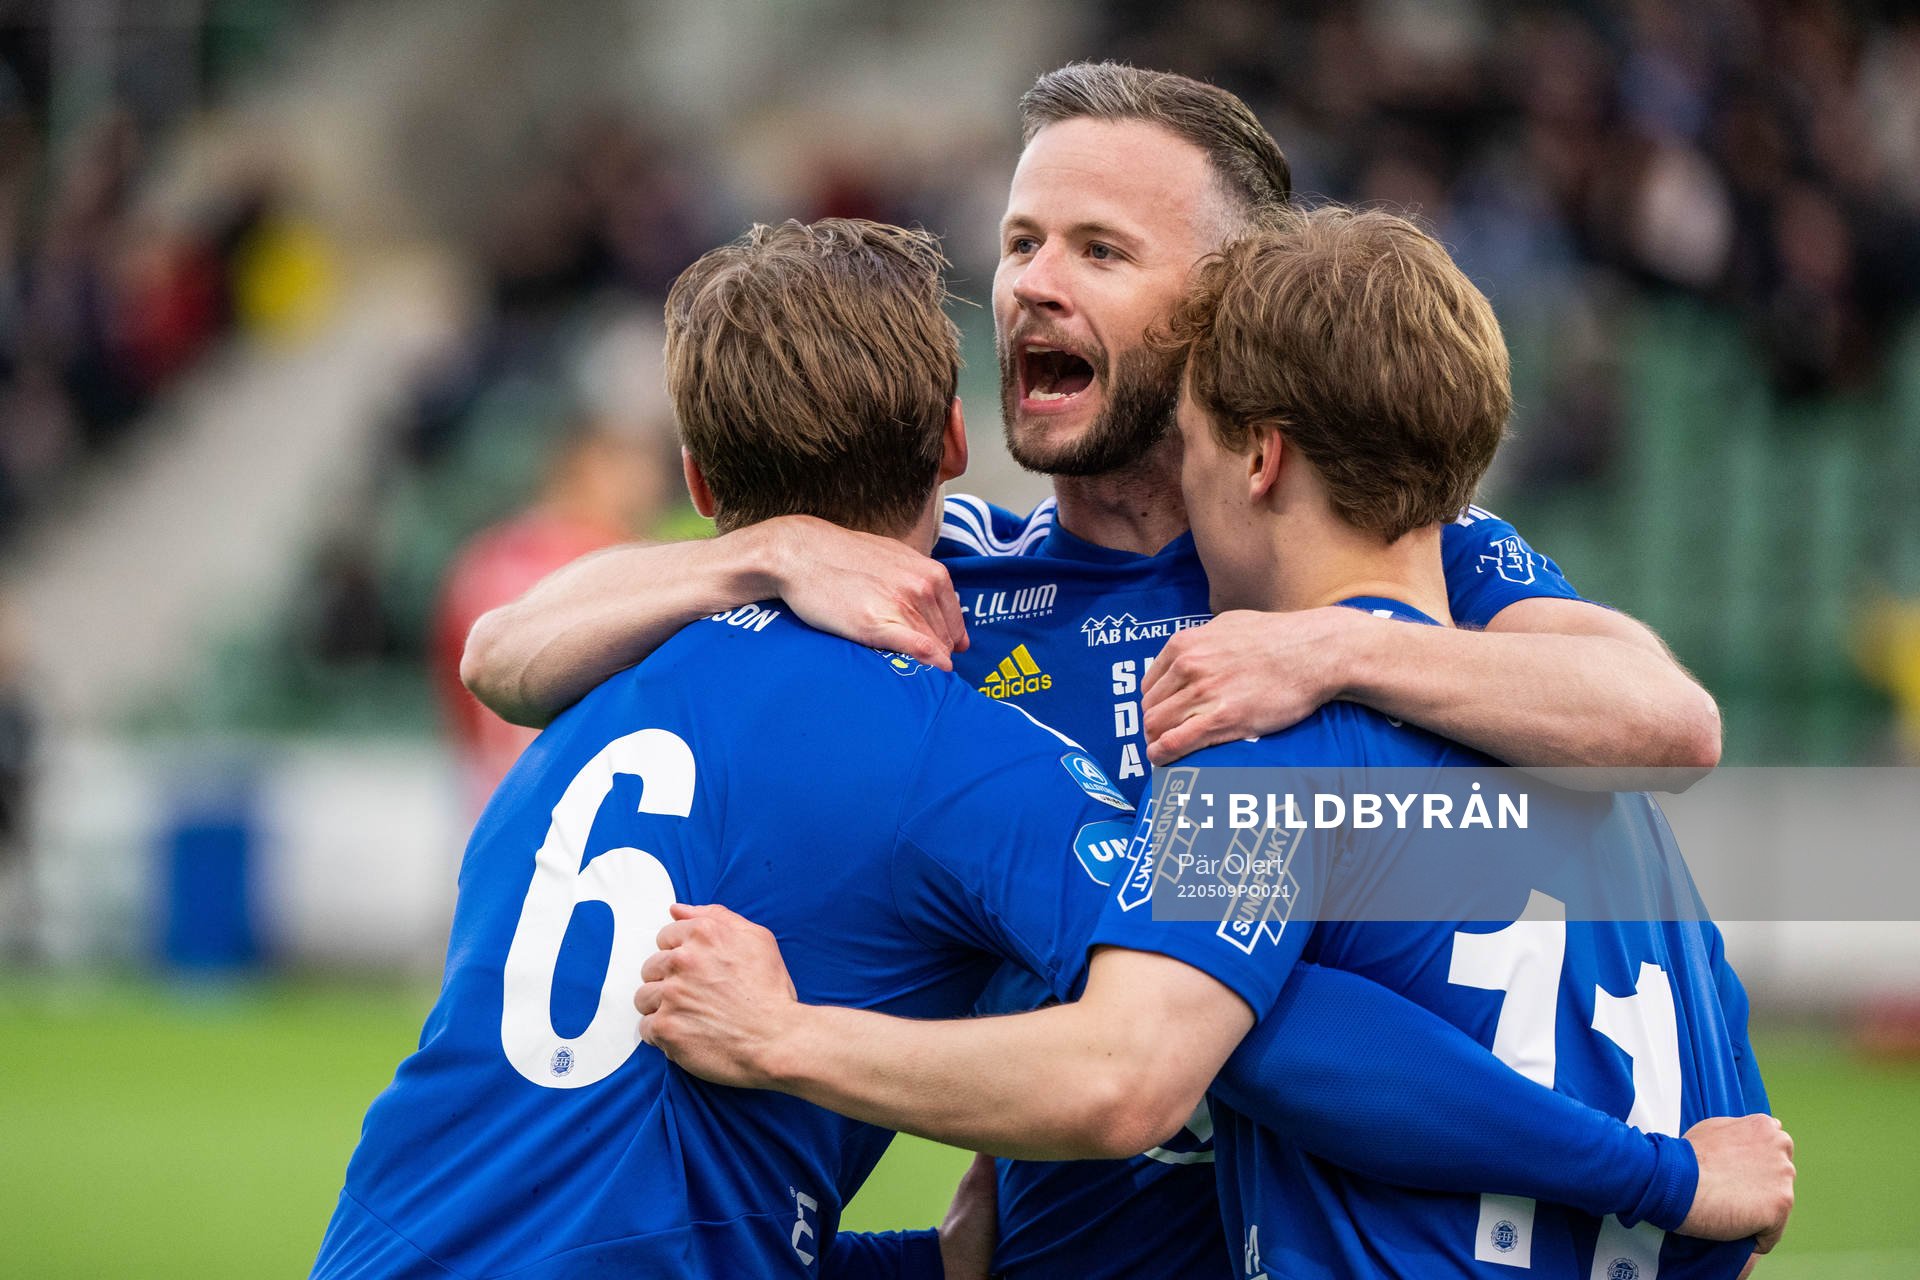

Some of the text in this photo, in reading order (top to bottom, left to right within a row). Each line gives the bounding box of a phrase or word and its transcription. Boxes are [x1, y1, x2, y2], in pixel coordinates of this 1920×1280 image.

[975, 584, 1057, 617] LILIUM
[702, 604, 780, 632] SON
[1125, 624, 1171, 642] KARL
[978, 674, 1053, 699] adidas
[501, 728, 696, 1089] 6
[1448, 888, 1682, 1280] 11
